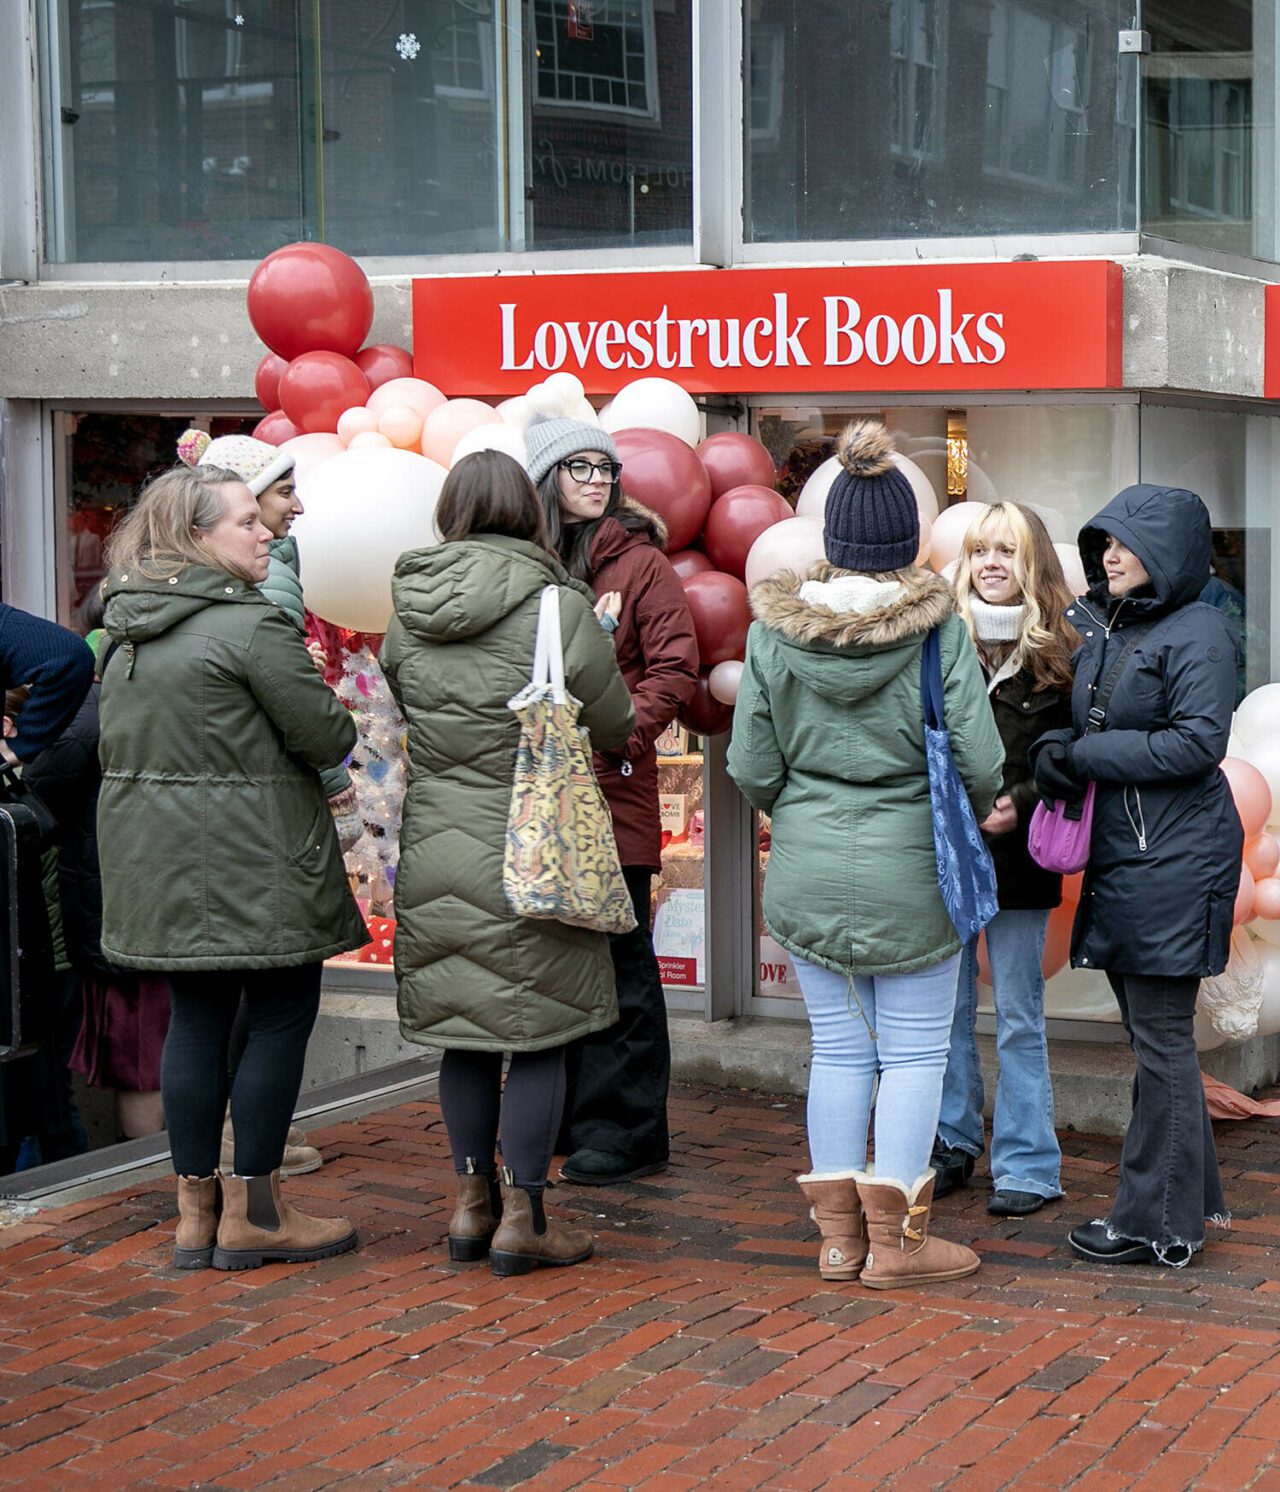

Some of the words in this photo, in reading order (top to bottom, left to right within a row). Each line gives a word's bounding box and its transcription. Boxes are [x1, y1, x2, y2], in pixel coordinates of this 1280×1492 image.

[499, 292, 810, 371] Lovestruck
[822, 288, 1006, 367] Books
[664, 914, 693, 928] Date
[666, 971, 687, 980] Room
[760, 963, 787, 984] OVE
